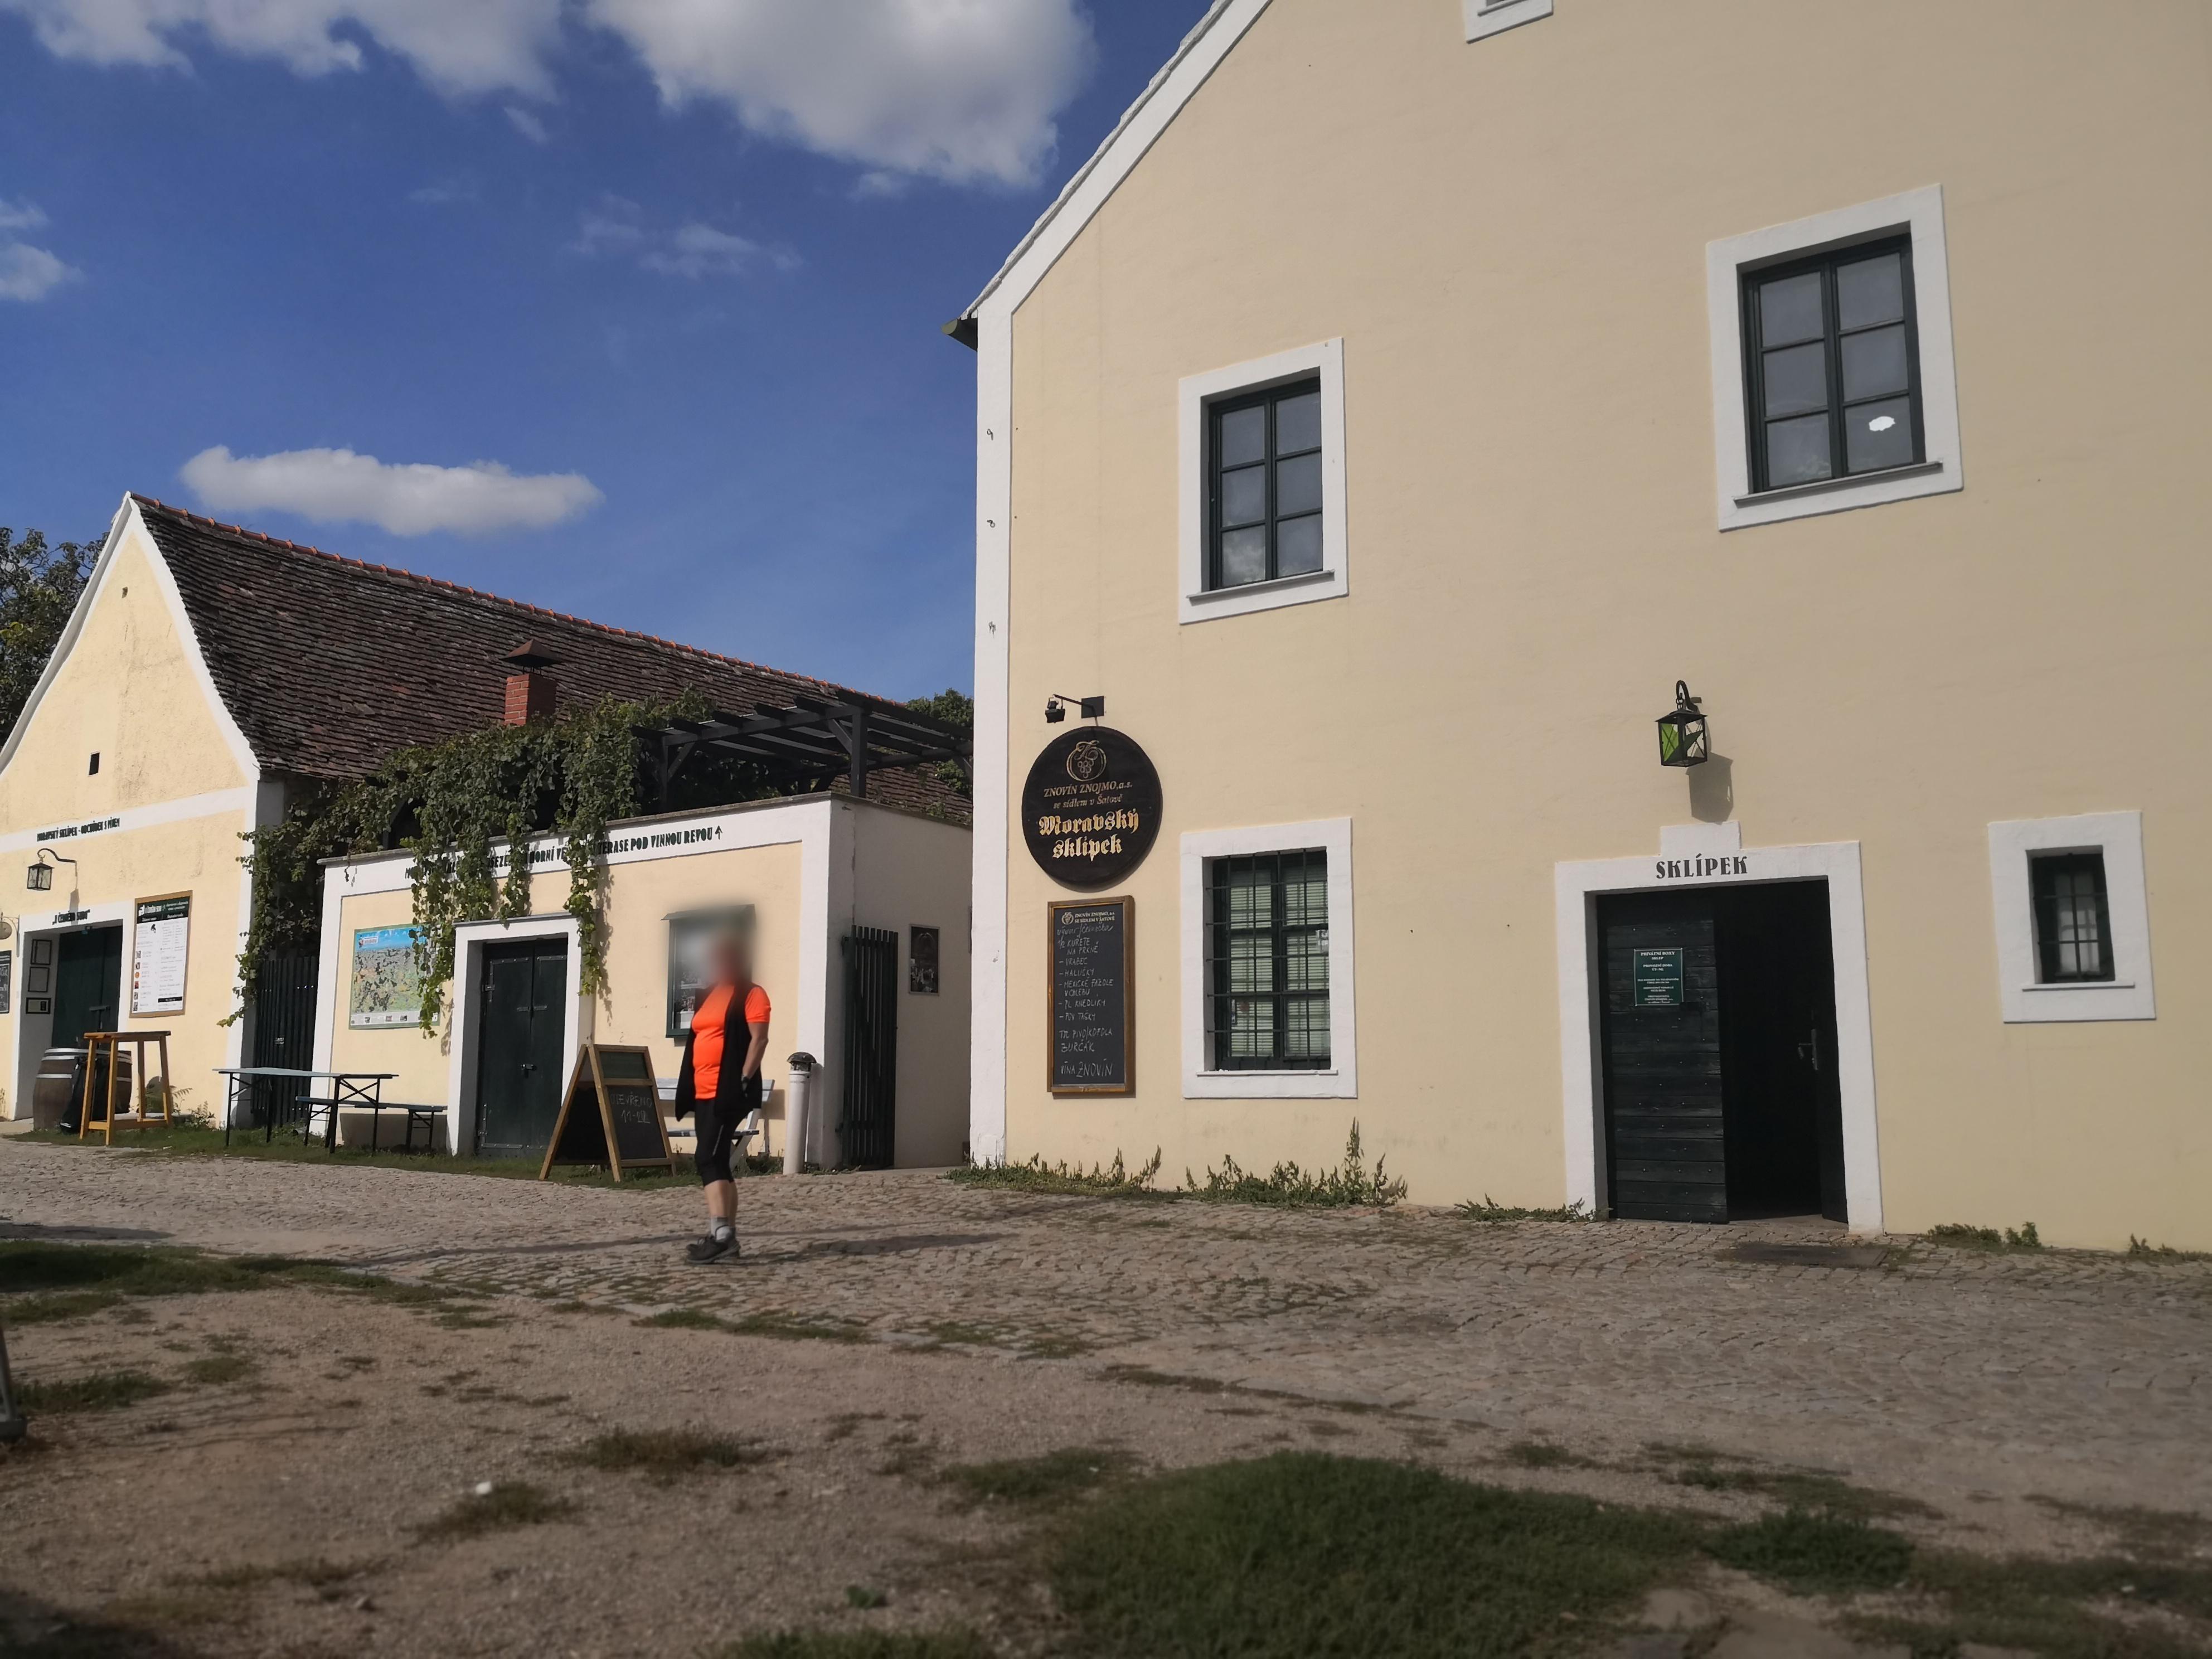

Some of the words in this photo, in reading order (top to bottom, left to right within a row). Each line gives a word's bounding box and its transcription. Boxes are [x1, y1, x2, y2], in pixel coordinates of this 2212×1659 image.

[1044, 783, 1076, 797] ZNOVÍN
[1063, 798, 1088, 808] sídlem
[1039, 808, 1139, 836] Moravský
[529, 846, 555, 864] HORNÍ
[598, 838, 629, 855] TERASE
[630, 837, 648, 851] POD
[651, 831, 682, 848] VINNOU
[1656, 853, 1748, 879] SKLÍPEK
[1065, 957, 1088, 966] VRABEC
[1065, 966, 1095, 977] HALUŠKY
[1076, 1058, 1113, 1078] ZNOVÍN
